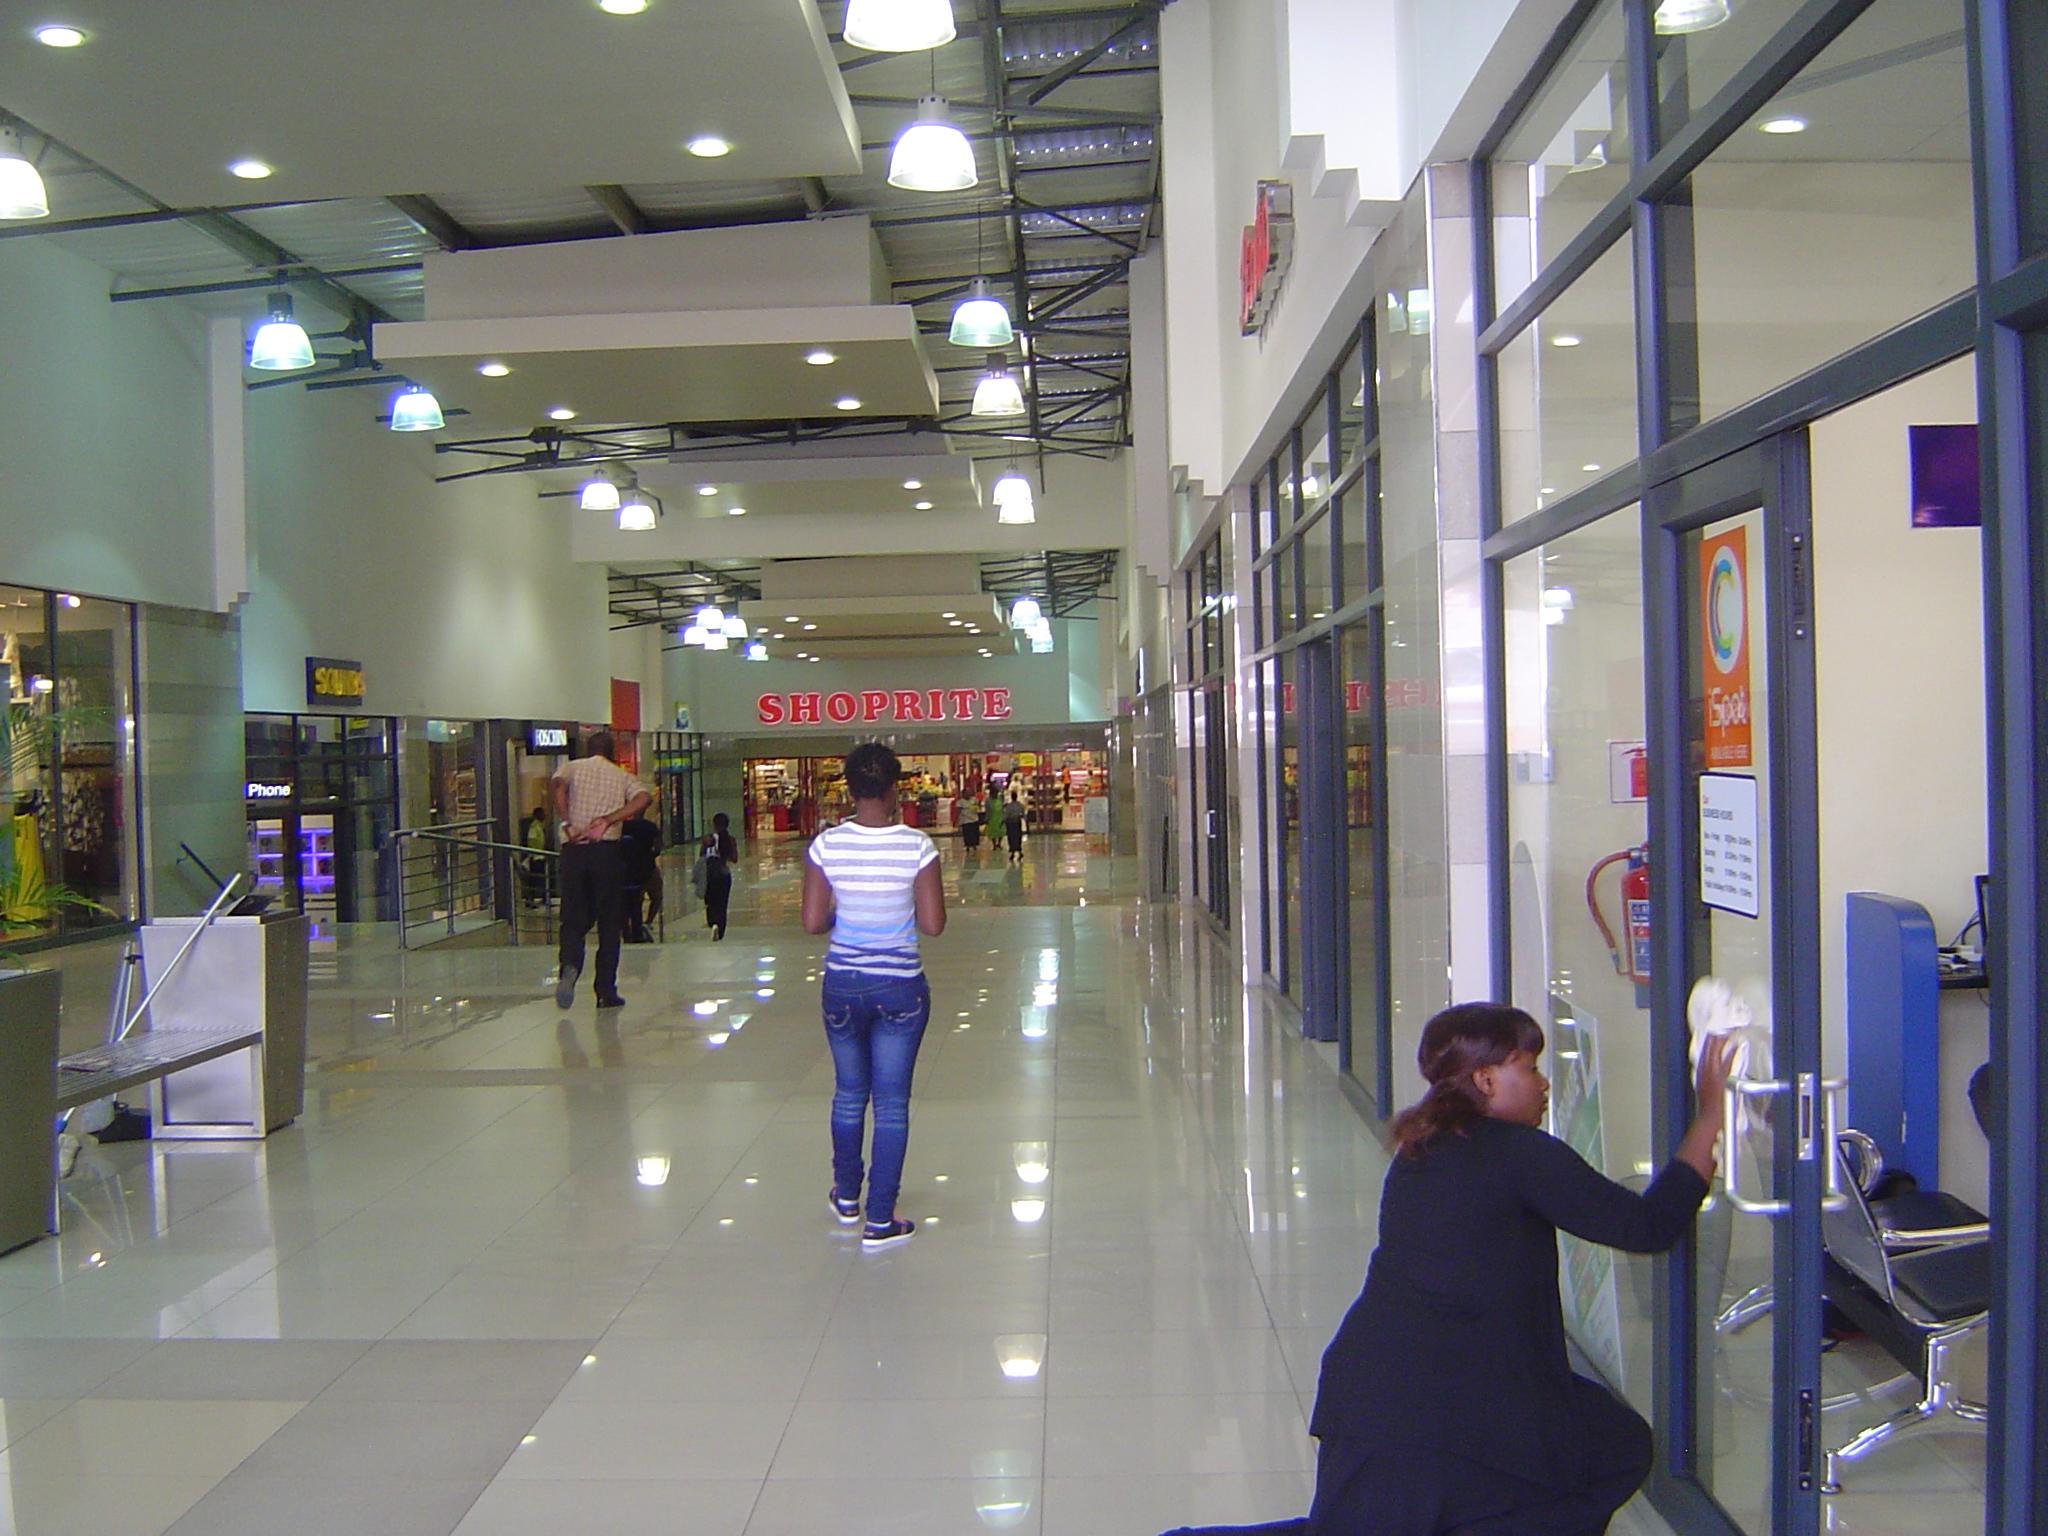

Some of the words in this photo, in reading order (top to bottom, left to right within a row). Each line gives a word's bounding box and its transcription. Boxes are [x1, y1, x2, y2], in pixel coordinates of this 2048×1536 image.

[758, 687, 1012, 725] SHOPRITE
[1708, 685, 1747, 737] iSpot
[248, 783, 291, 797] Phone
